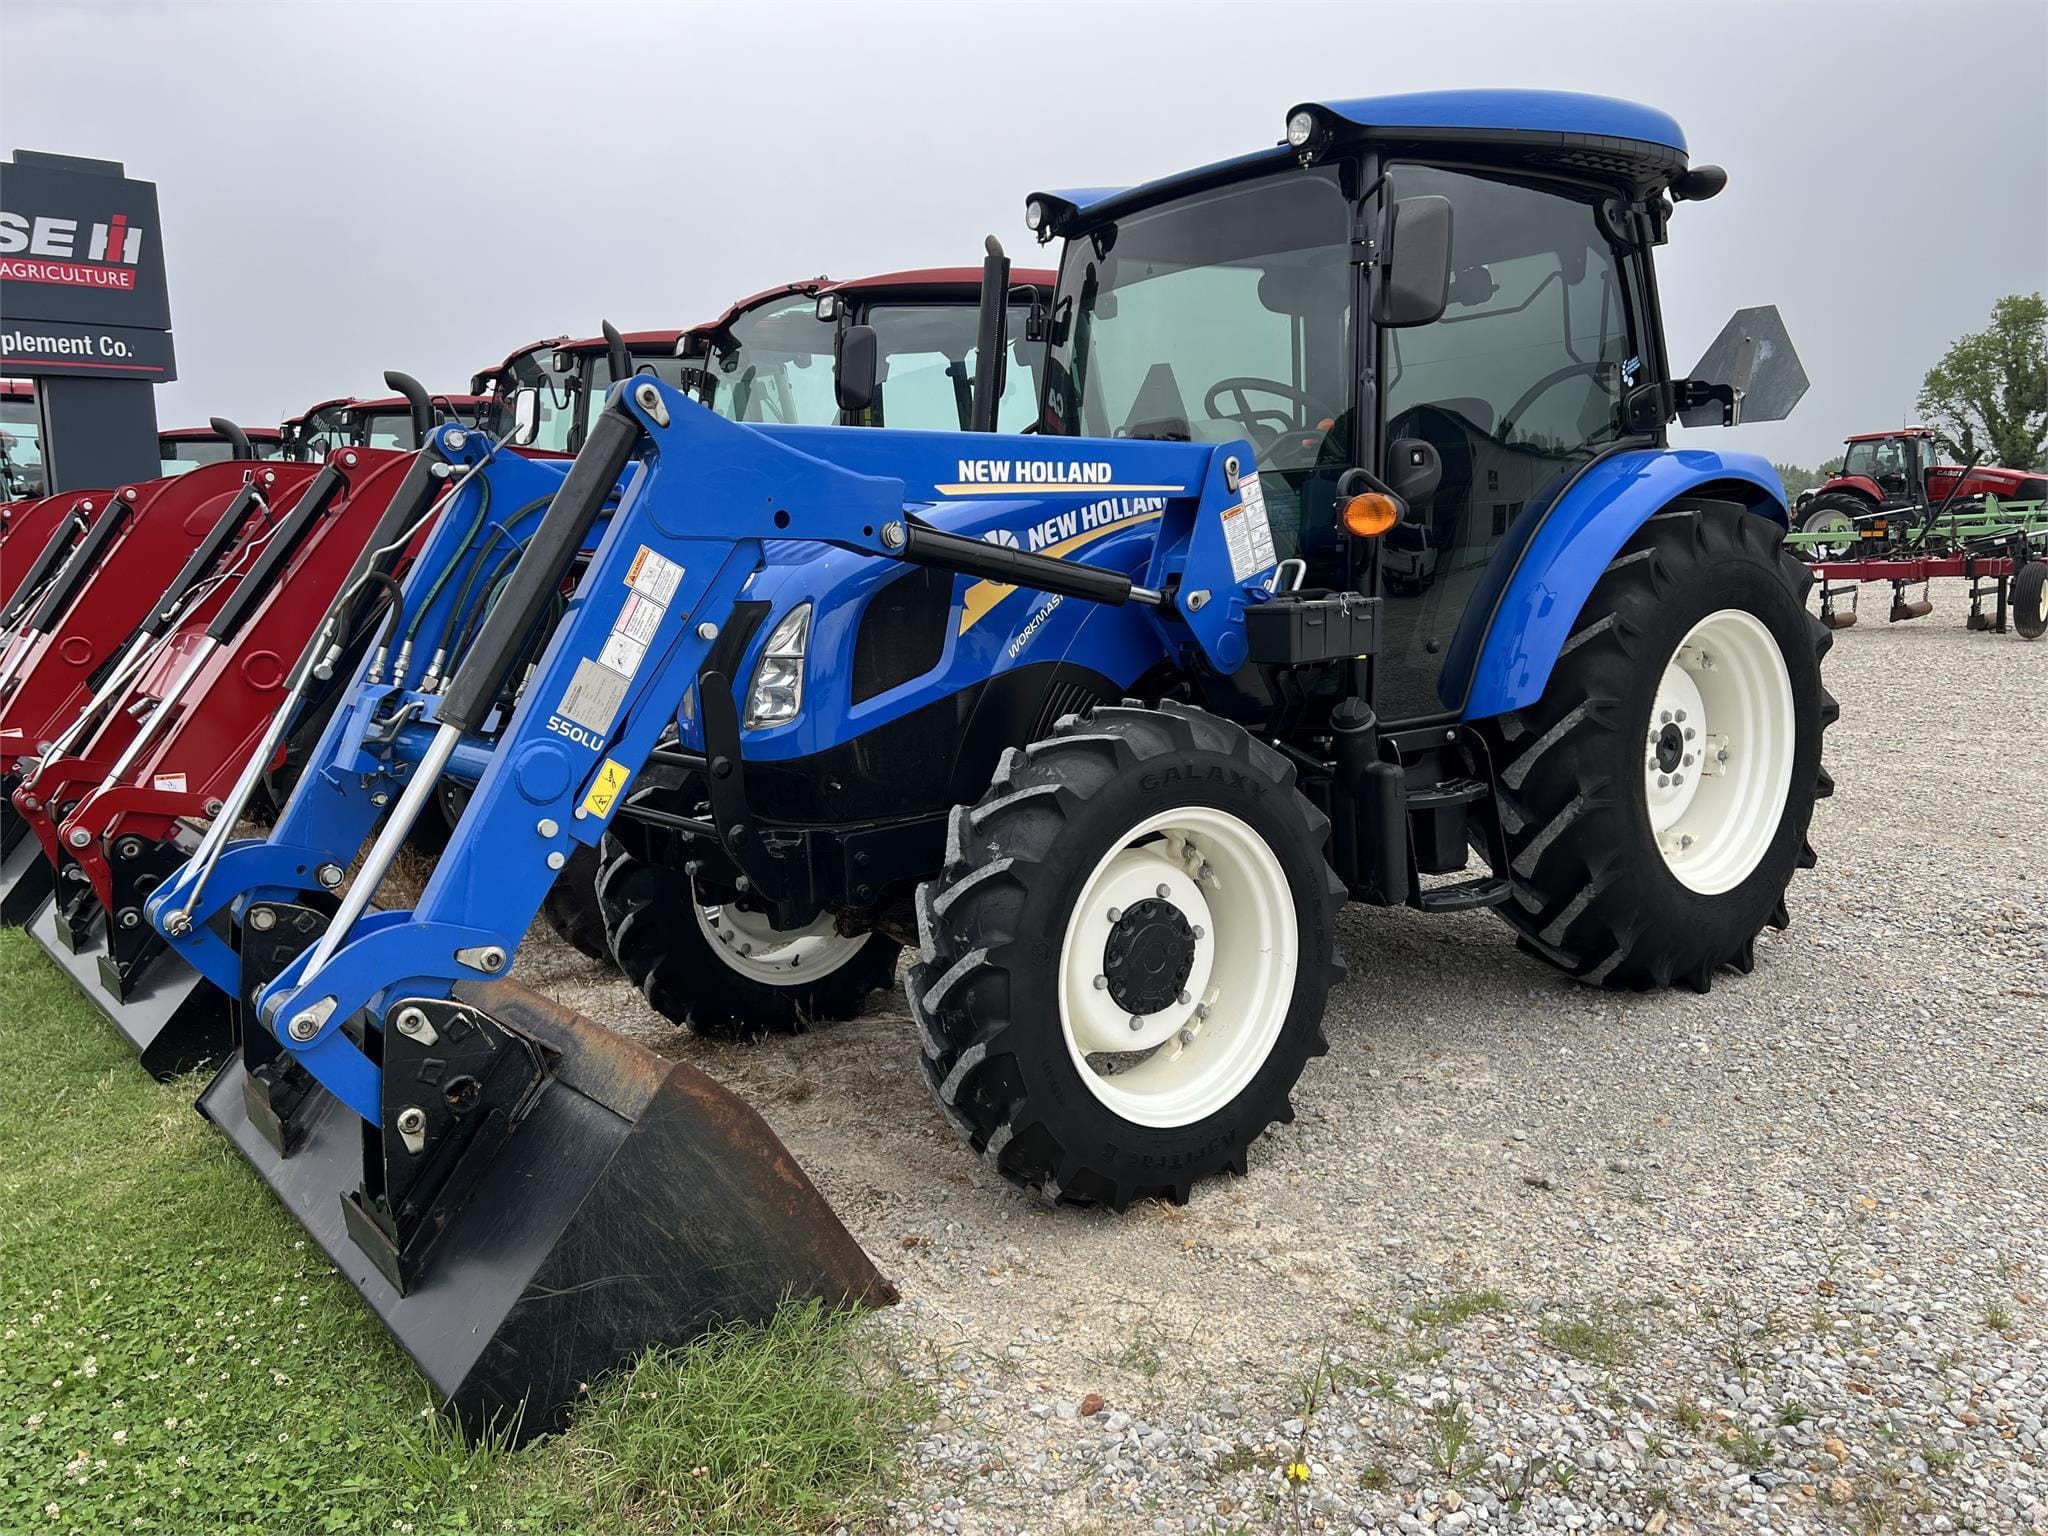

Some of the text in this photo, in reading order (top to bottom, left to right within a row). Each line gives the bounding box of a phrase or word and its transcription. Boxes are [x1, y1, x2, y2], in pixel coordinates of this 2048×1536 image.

[0, 262, 130, 286] AGRICULTURE
[99, 336, 133, 358] Co.
[958, 460, 1112, 483] NEW HOLLAND
[1028, 497, 1167, 552] NEW HOLLAN
[546, 715, 604, 751] 550LU
[1138, 764, 1268, 801] GALAXY
